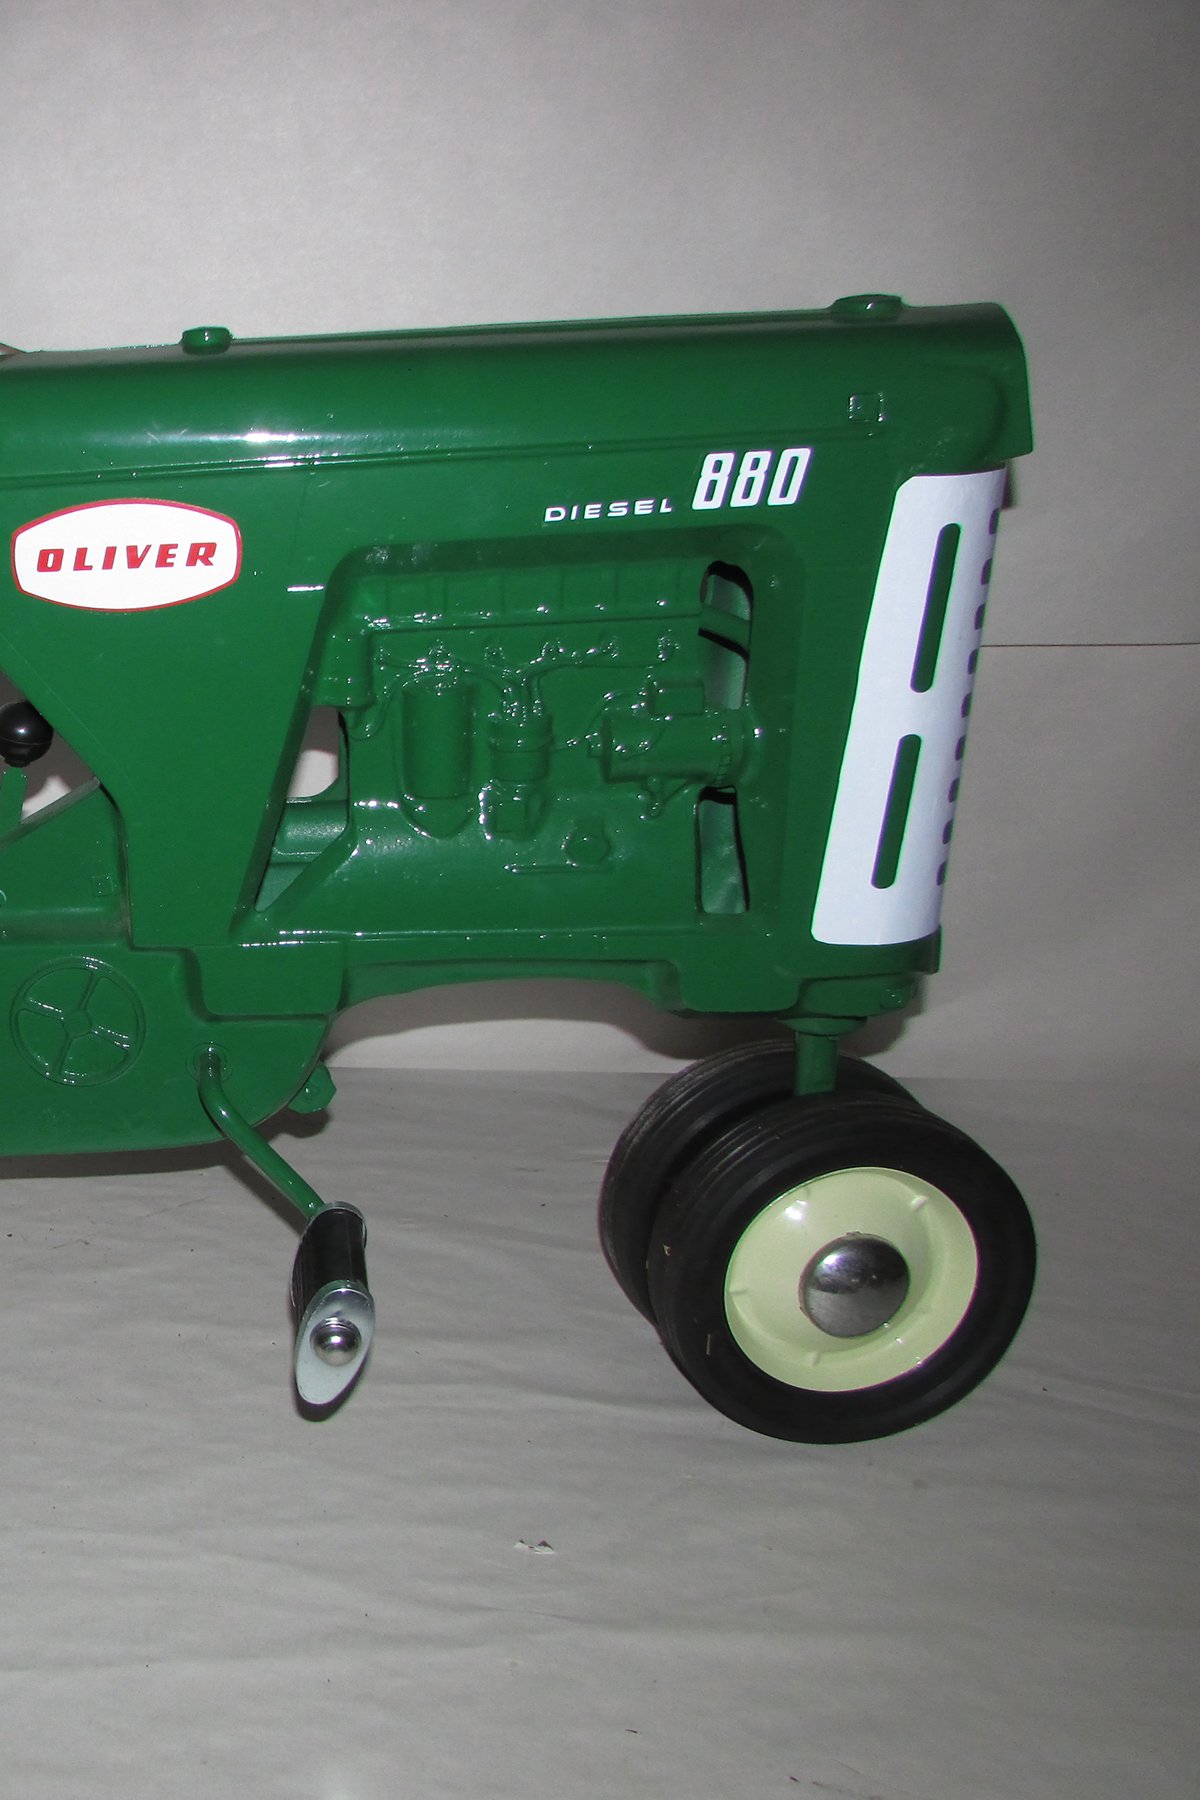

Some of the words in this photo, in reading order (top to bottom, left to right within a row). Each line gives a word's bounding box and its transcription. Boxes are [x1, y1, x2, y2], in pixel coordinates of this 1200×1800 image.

[544, 498, 672, 522] DIESEL
[692, 447, 811, 510] 880
[37, 542, 217, 572] OLIVER
